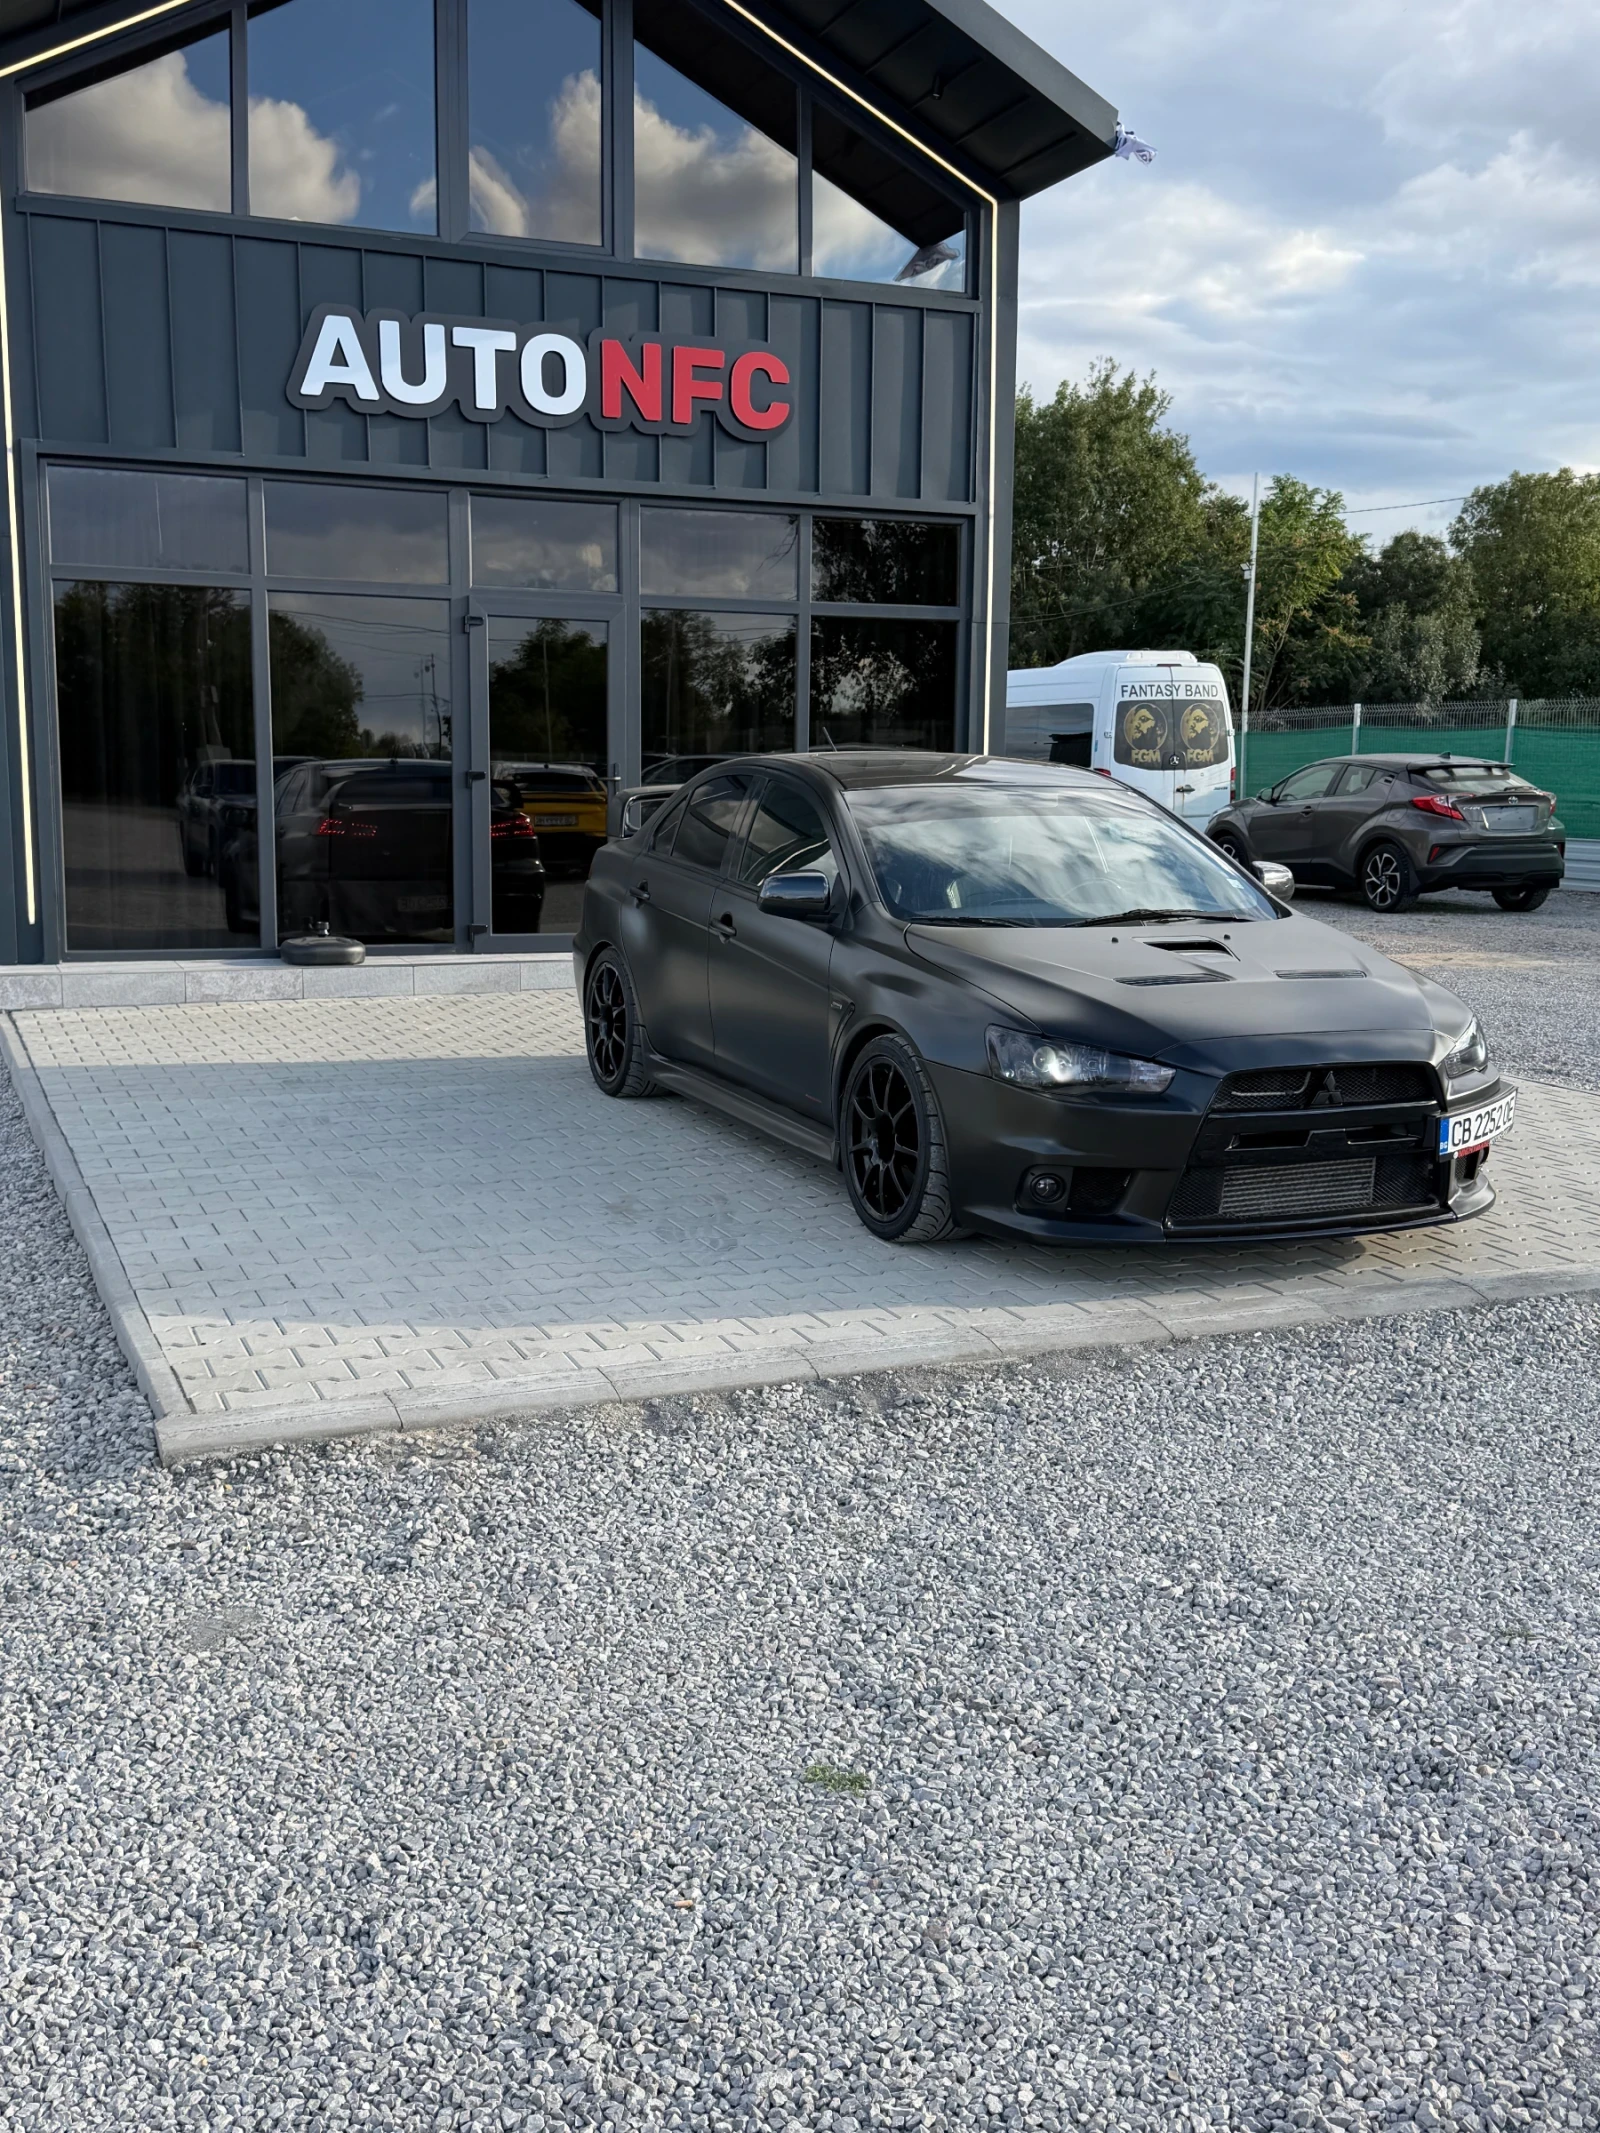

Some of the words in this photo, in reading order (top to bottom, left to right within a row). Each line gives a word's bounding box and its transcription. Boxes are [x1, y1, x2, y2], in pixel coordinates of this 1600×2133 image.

[1121, 684, 1180, 698] FANTASY
[1185, 684, 1218, 697] BAND
[1131, 749, 1160, 763] FGM
[1187, 749, 1214, 763] FGM
[1452, 1117, 1472, 1147] CB
[1474, 1104, 1503, 1140] 2252
